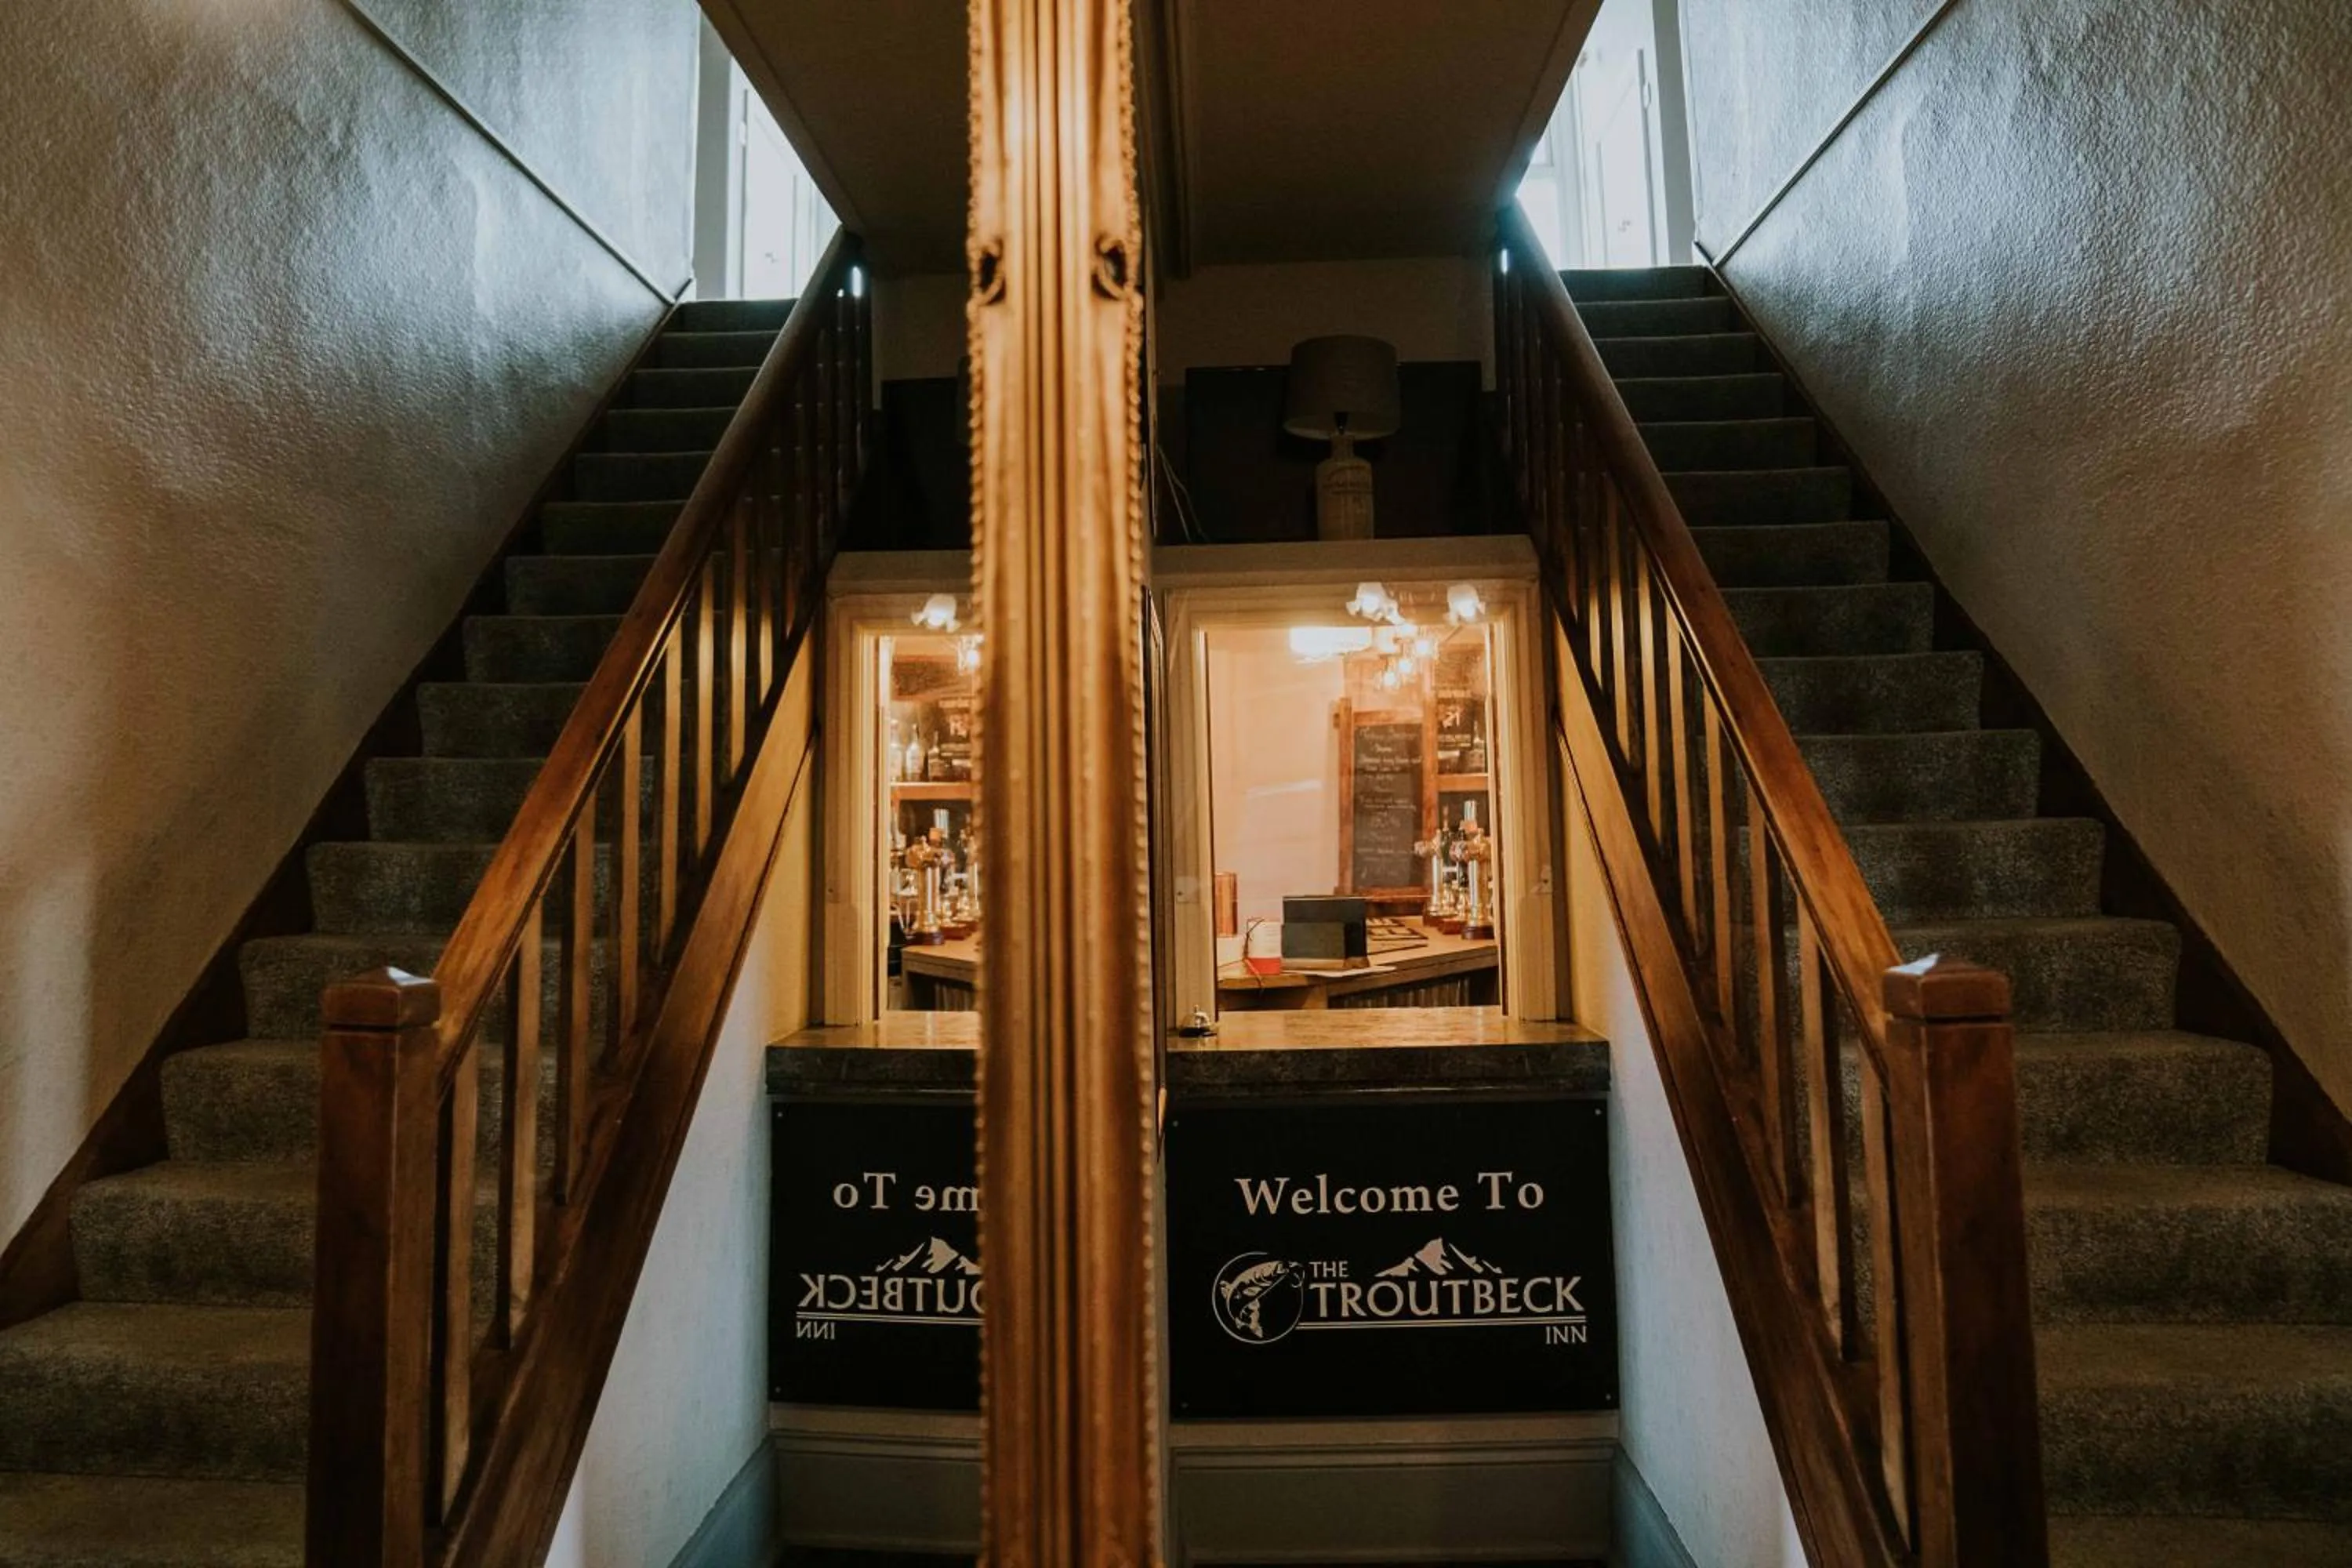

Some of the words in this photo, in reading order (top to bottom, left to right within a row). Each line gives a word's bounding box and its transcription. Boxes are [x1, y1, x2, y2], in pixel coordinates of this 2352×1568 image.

[1234, 1173, 1459, 1215] Welcome
[1477, 1171, 1544, 1210] To
[1308, 1260, 1349, 1279] THE
[1308, 1276, 1585, 1318] TROUTBECK
[1545, 1325, 1588, 1345] INN
